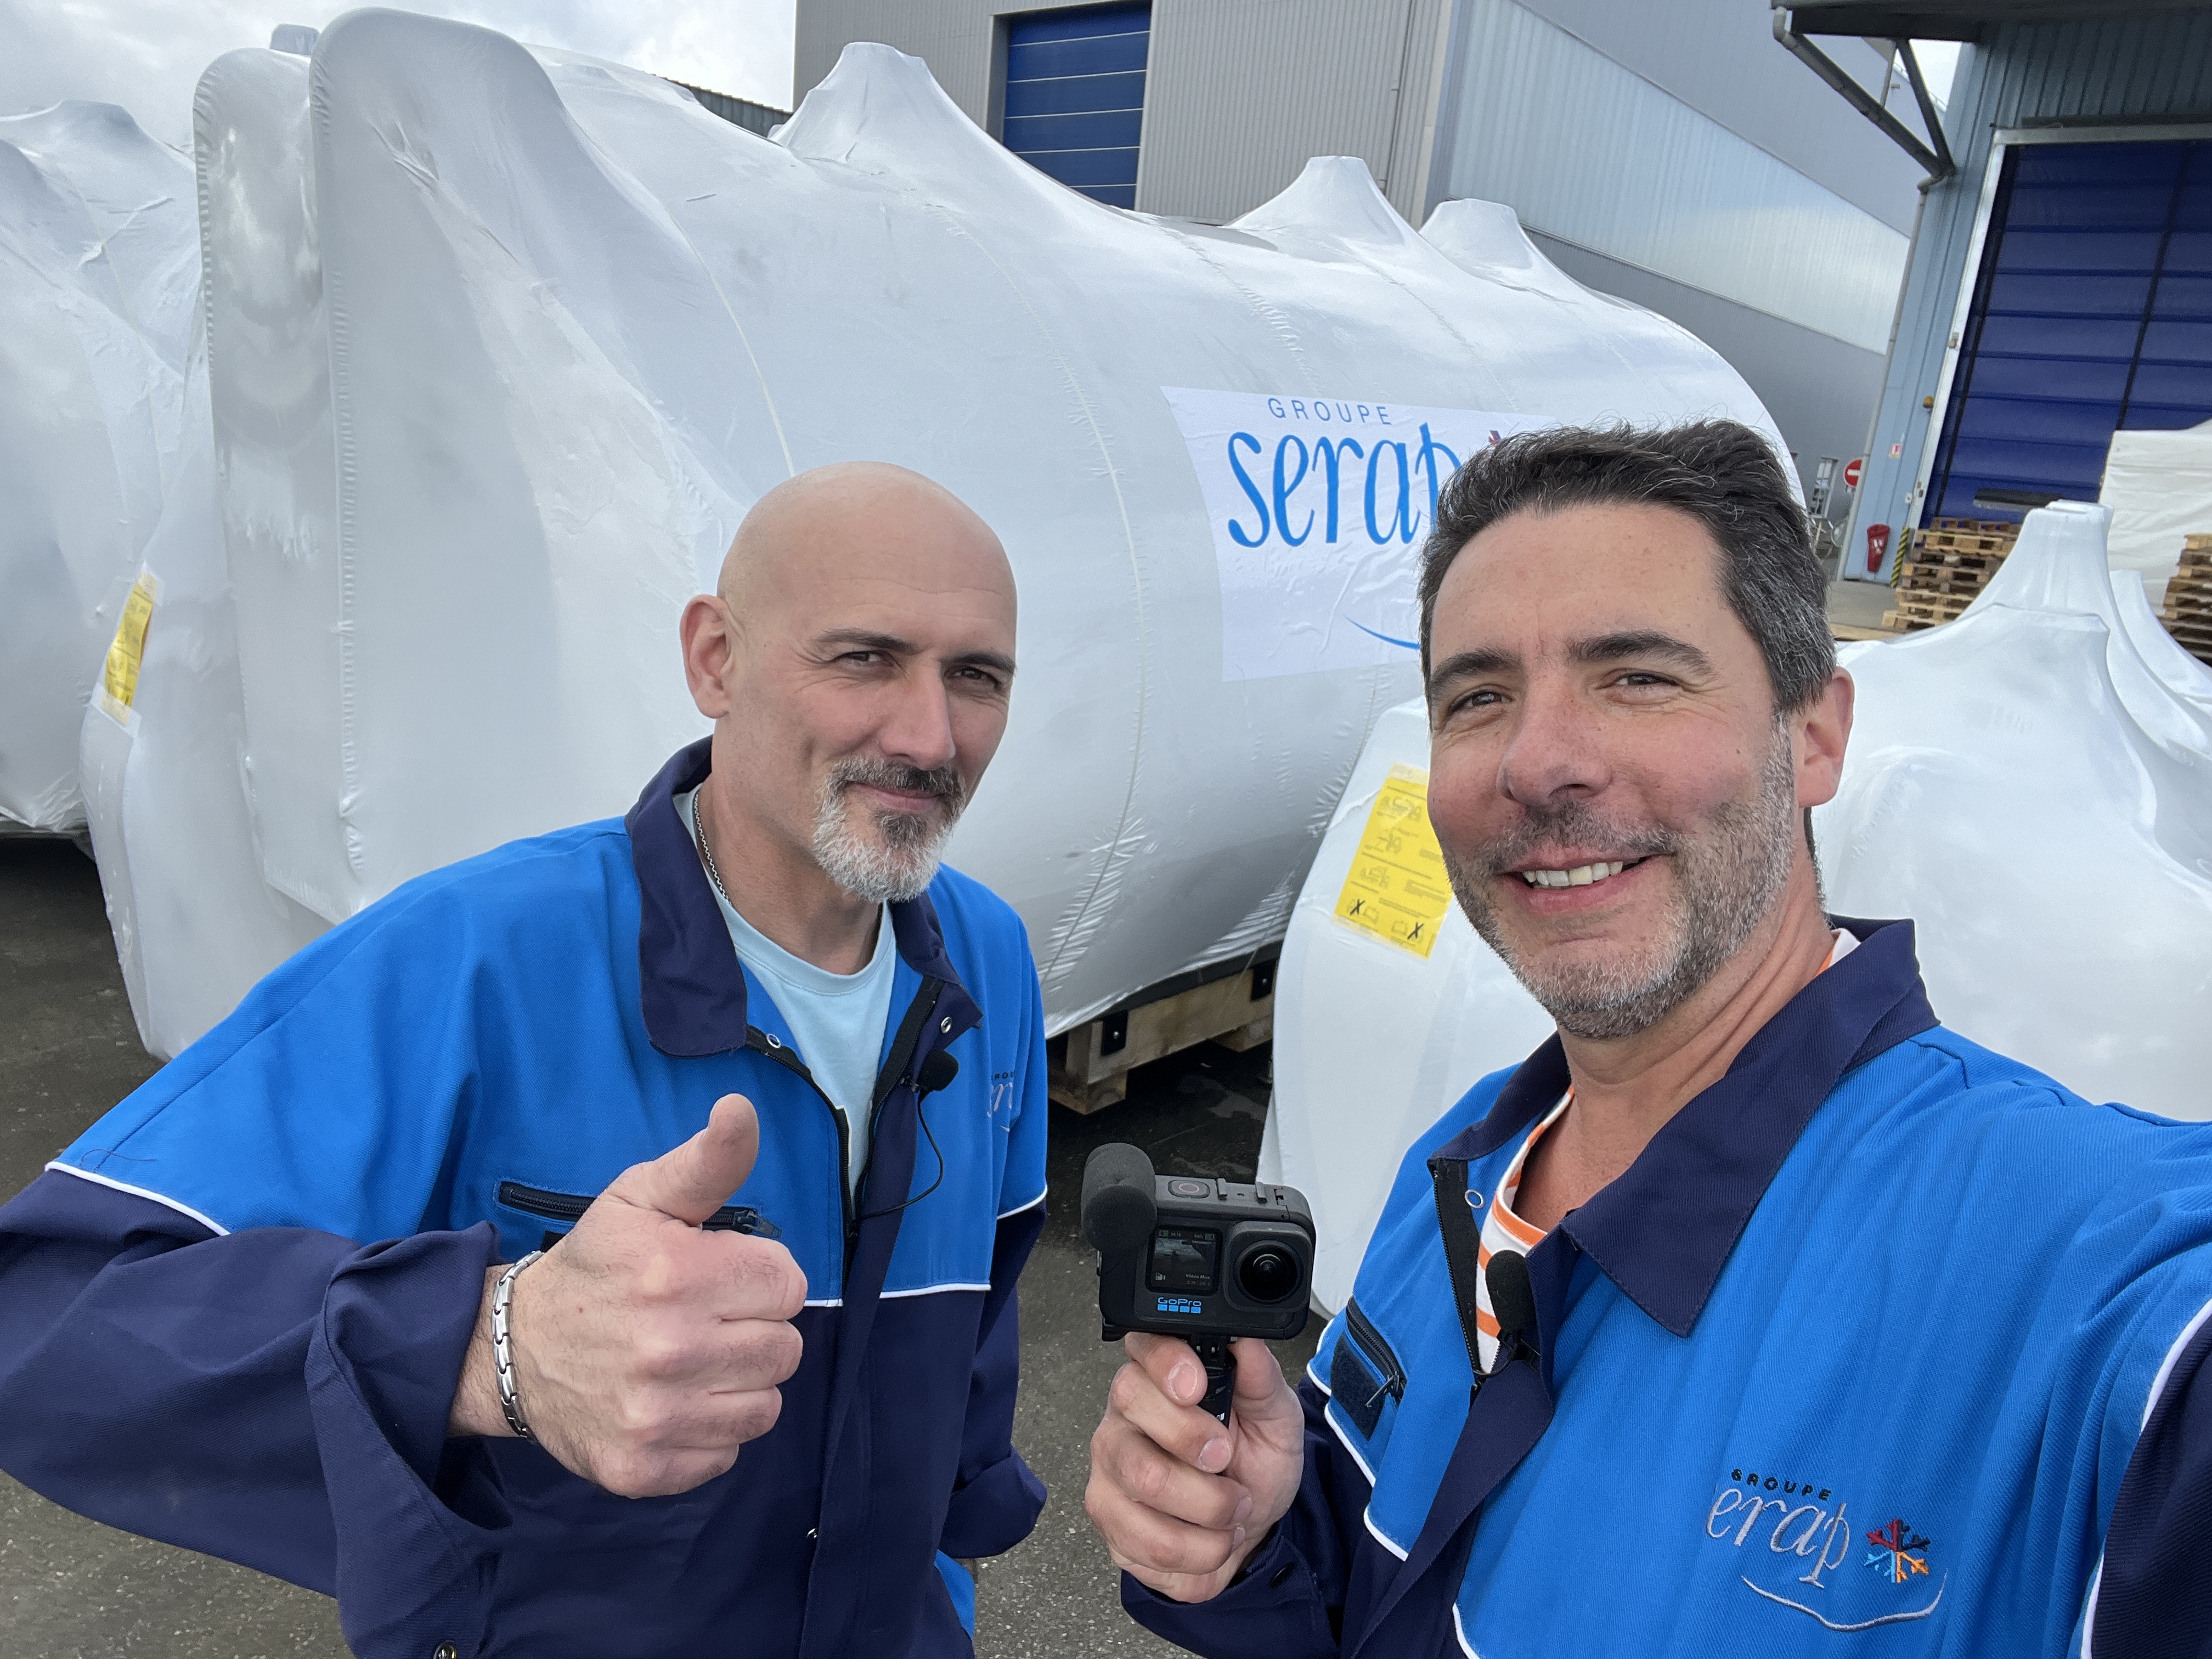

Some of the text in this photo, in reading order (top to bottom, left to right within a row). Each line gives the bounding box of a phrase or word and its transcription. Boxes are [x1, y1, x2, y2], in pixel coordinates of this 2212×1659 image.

[1267, 397, 1392, 426] GROUPE
[1158, 1297, 1202, 1307] GoPro
[1730, 1468, 1832, 1502] GROUPE
